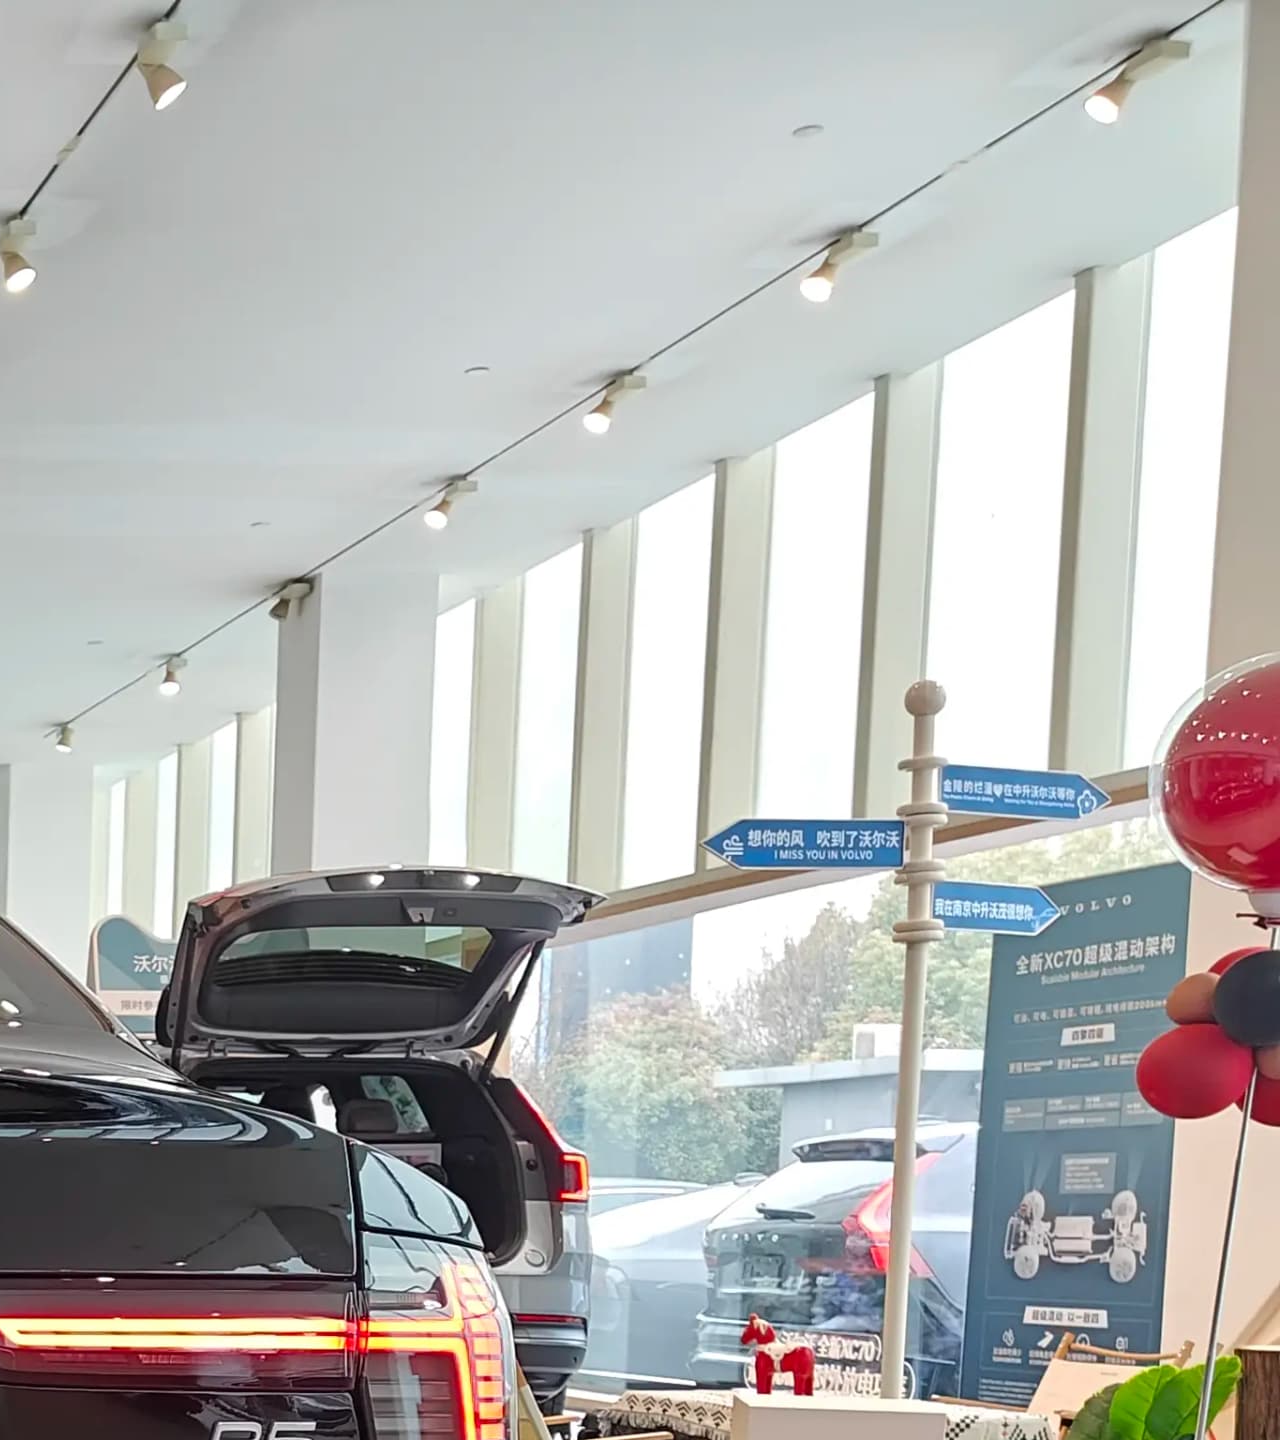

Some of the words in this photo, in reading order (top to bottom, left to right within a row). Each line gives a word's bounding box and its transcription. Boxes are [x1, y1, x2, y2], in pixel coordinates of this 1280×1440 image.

[748, 830, 804, 848] 想你的风
[816, 830, 900, 848] 吹到了沃尔沃
[779, 851, 803, 860] MISS
[806, 851, 826, 860] YOU
[827, 851, 838, 860] IN
[840, 851, 873, 860] VOLVO
[1061, 895, 1132, 915] VOLVO
[1016, 933, 1176, 975] 全新XC70超级混动架构
